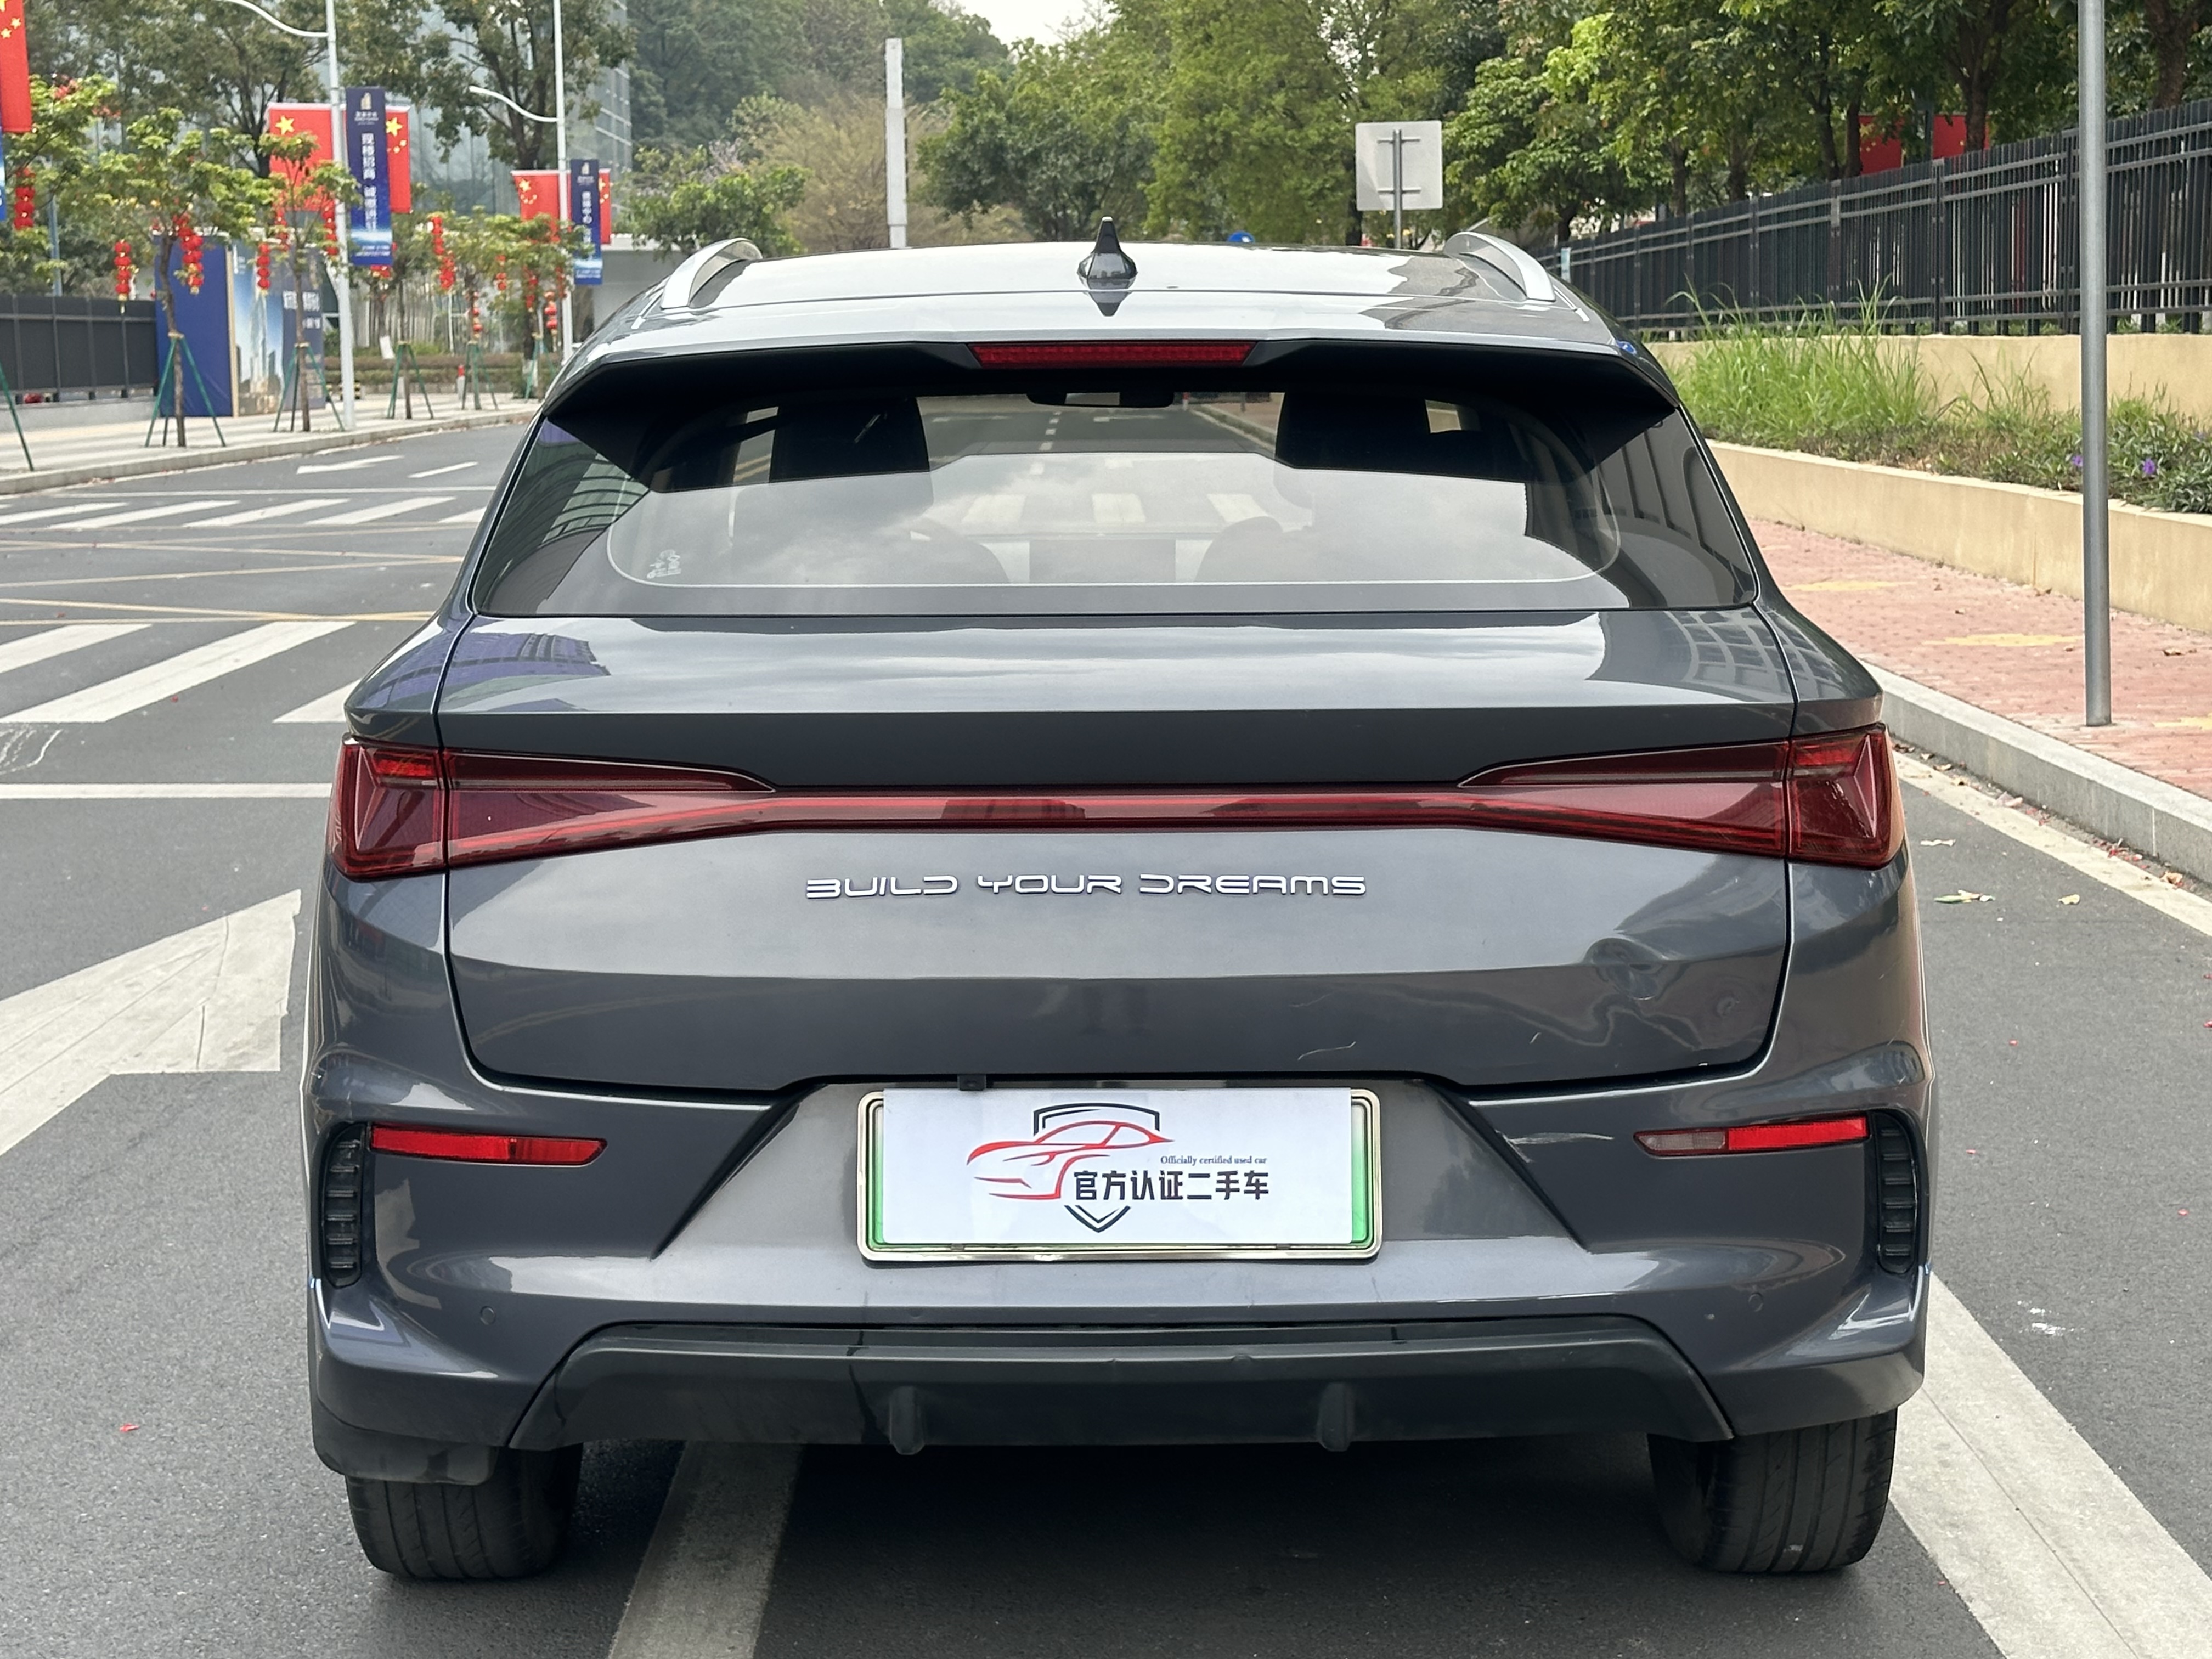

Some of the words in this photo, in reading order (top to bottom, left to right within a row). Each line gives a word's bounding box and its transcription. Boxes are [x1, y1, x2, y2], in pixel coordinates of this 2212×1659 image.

[806, 876, 958, 899] BUILD
[978, 874, 1122, 894] YOUR
[1139, 874, 1367, 895] DREAMS
[1160, 1155, 1197, 1166] Officially
[1199, 1155, 1232, 1164] certified
[1234, 1155, 1252, 1164] used
[1073, 1170, 1269, 1200] 官方认证二手车
